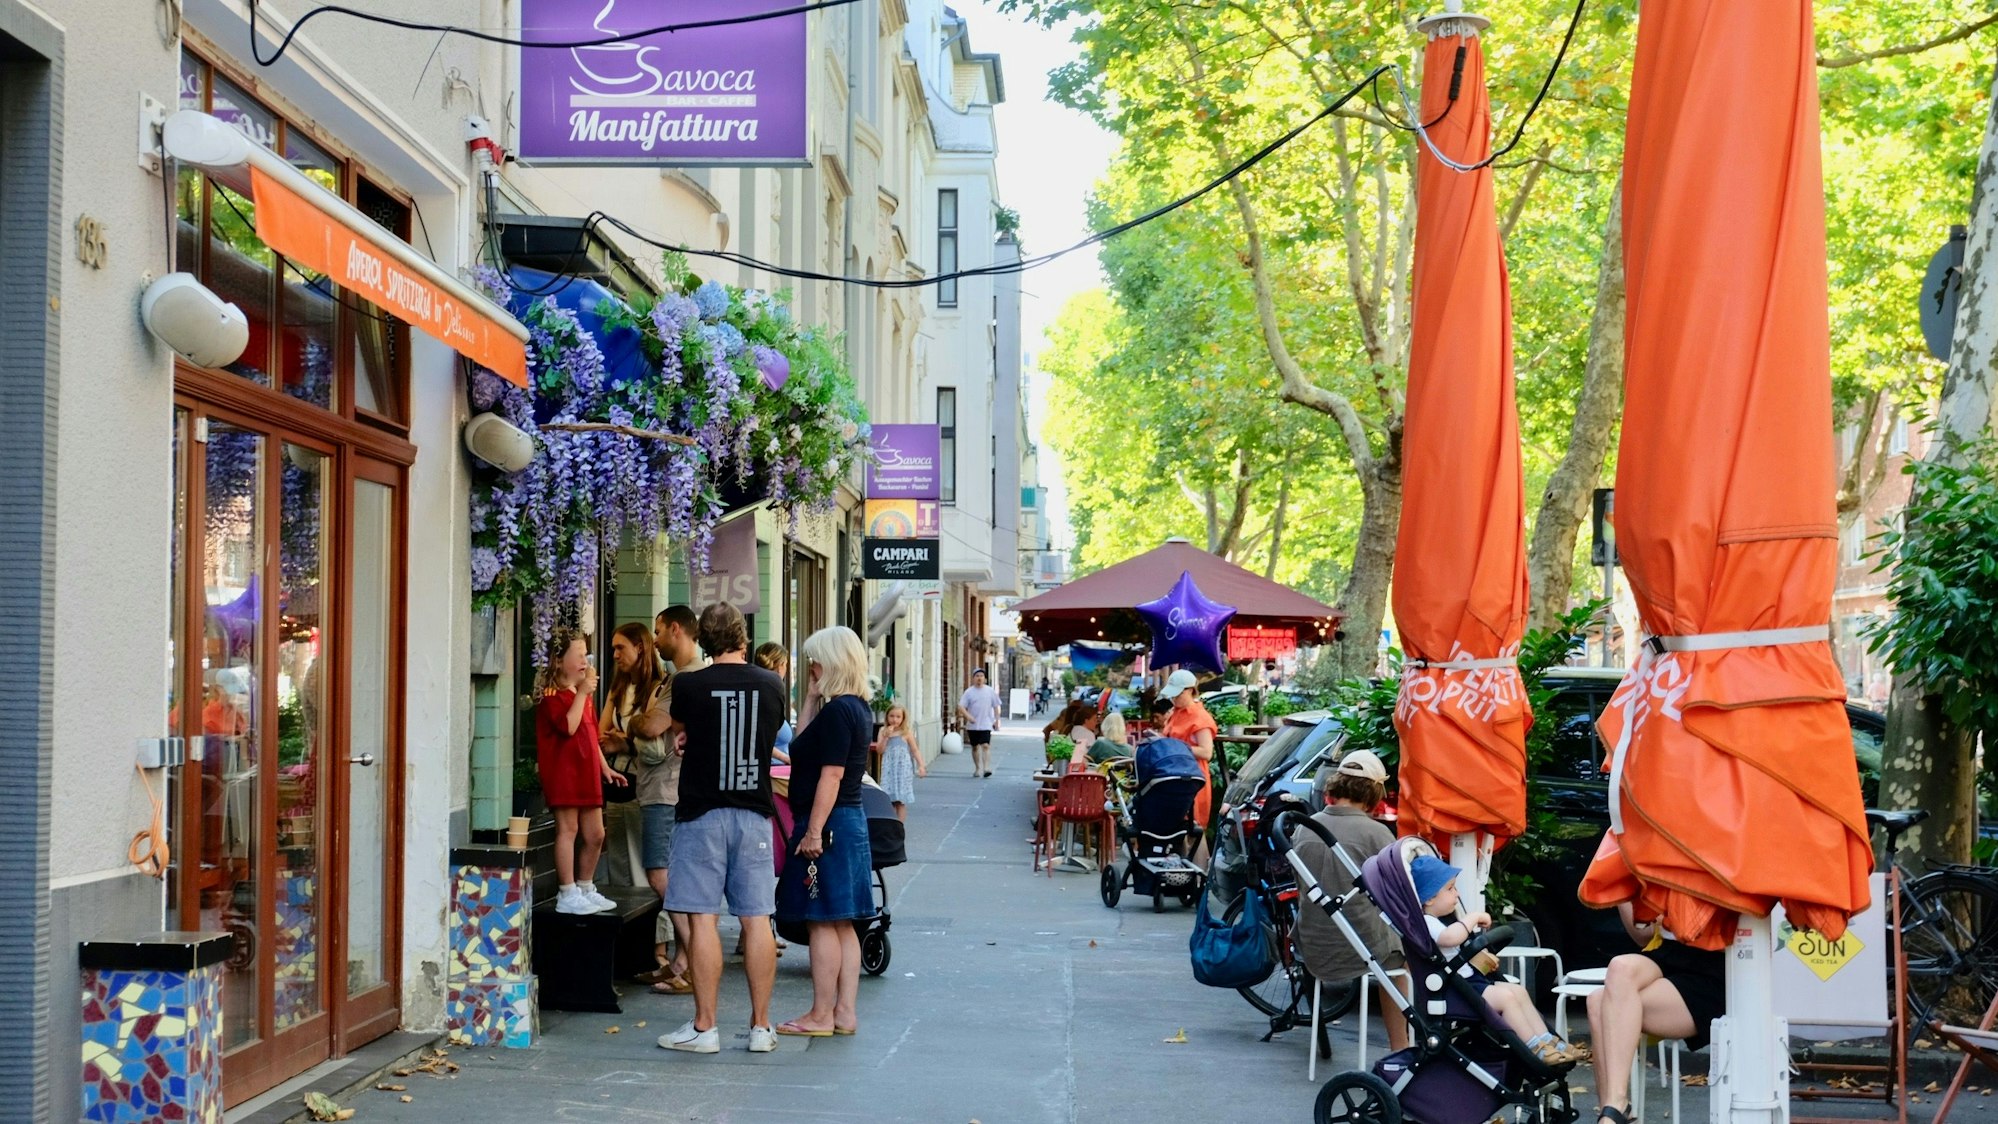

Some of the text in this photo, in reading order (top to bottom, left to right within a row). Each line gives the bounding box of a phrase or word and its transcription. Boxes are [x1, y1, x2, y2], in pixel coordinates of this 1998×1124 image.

[635, 46, 755, 96] Savoca
[569, 110, 758, 151] Manifattura
[894, 450, 932, 465] Savoca
[920, 503, 936, 527] T
[873, 547, 929, 561] CAMPARI
[696, 574, 753, 608] EIS
[736, 766, 758, 790] 22
[1798, 930, 1845, 957] SUN
